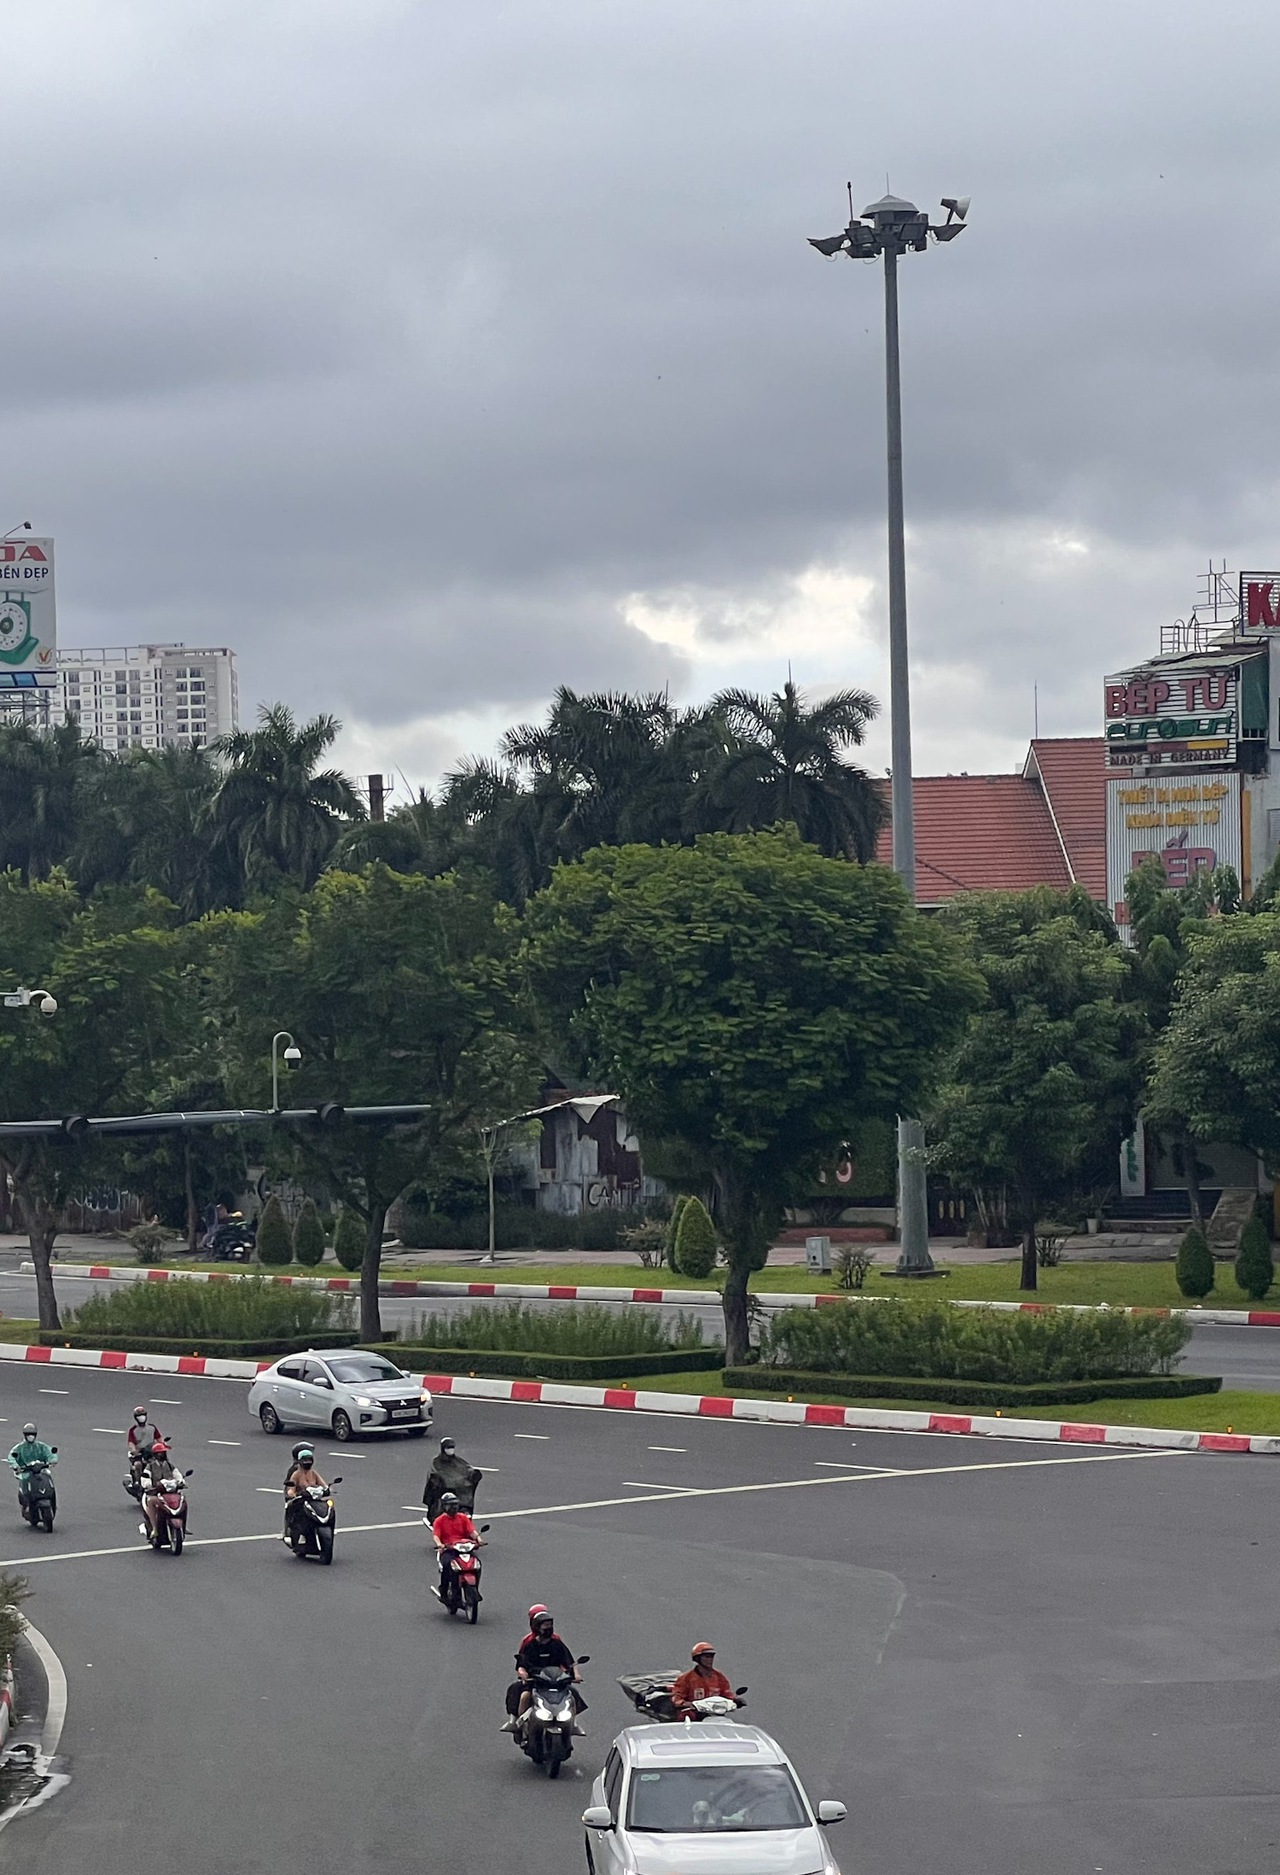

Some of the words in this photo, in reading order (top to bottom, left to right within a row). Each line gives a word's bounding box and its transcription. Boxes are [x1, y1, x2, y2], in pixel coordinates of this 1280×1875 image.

[24, 567, 49, 582] ĐẸP
[1247, 583, 1280, 627] K
[1107, 672, 1170, 718] BẾP
[1110, 753, 1143, 766] MADE
[1149, 752, 1161, 764] IN
[1170, 748, 1228, 763] GERMANY
